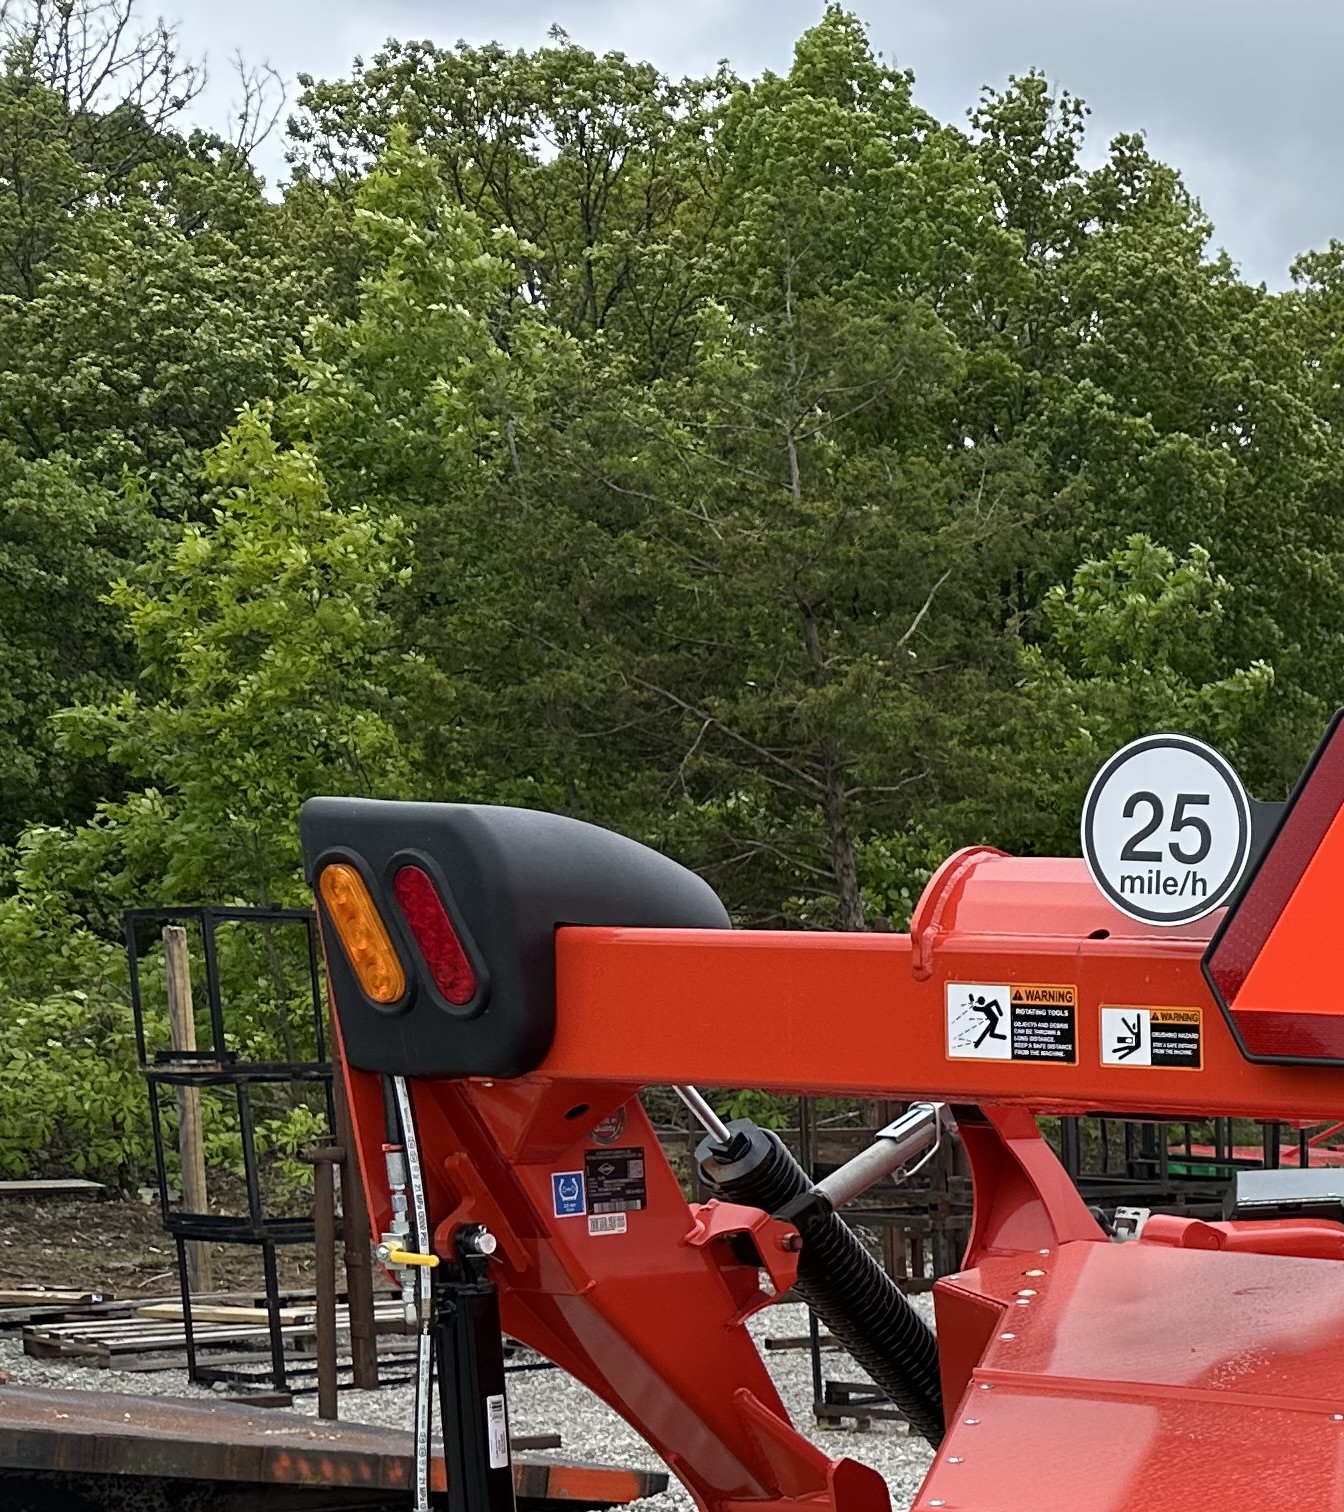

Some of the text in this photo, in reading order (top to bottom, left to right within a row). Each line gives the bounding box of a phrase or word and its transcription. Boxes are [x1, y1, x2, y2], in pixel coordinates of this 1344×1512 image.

[1120, 791, 1212, 865] 25
[1120, 869, 1207, 896] mile/h
[1025, 989, 1073, 1003] WARNING
